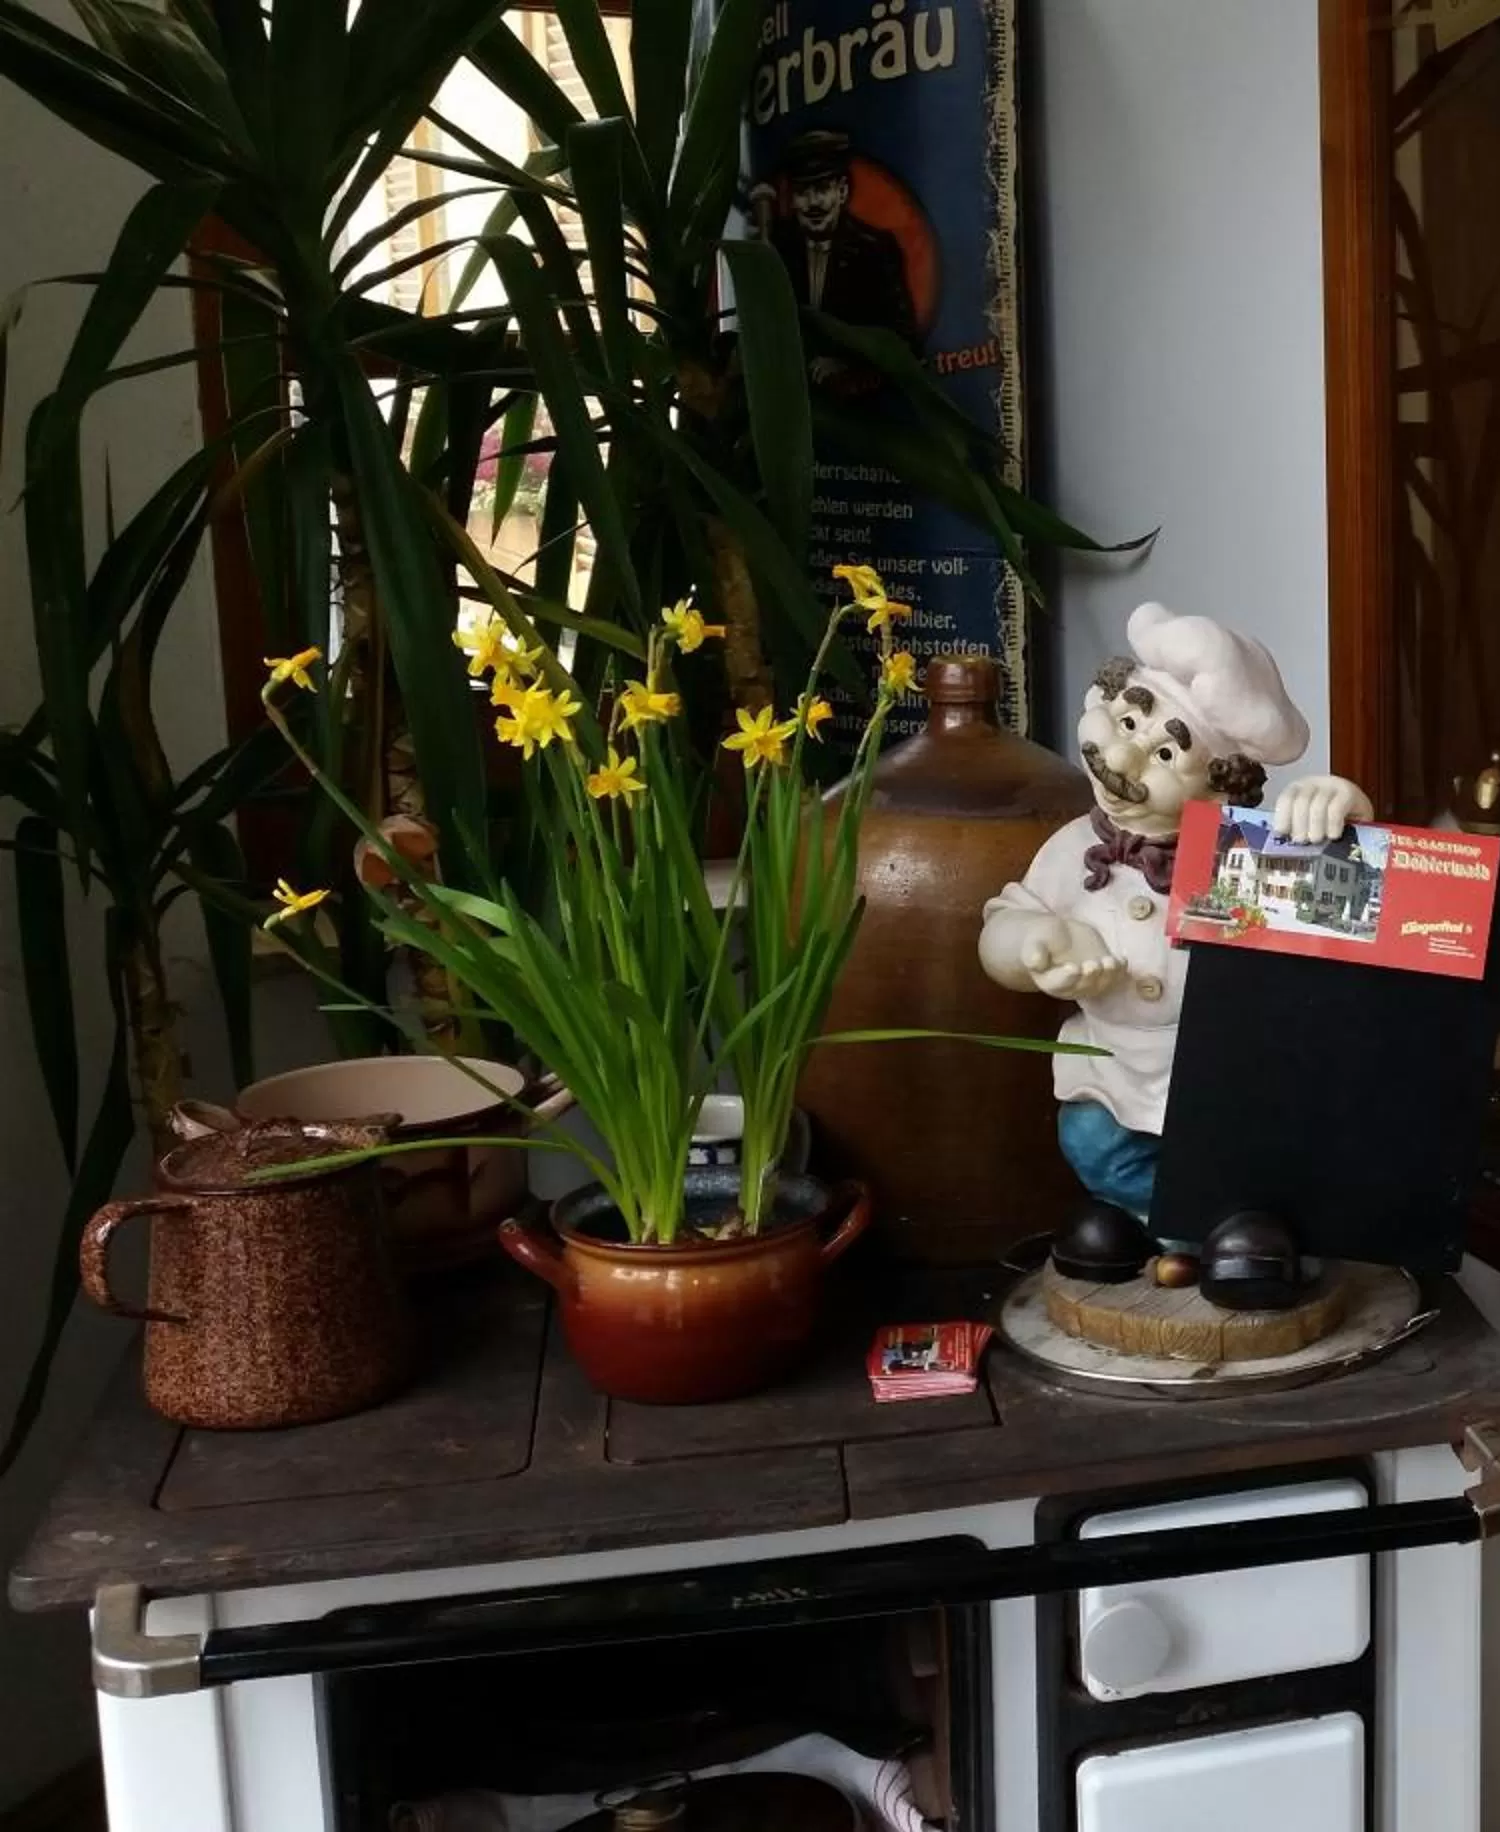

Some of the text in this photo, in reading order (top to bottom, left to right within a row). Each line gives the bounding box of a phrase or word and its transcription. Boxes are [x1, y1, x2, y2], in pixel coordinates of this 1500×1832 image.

[756, 0, 789, 48] ell
[750, 2, 956, 126] erbräu
[936, 340, 998, 373] treu!
[852, 499, 914, 521] werden
[876, 556, 928, 576] unser
[930, 556, 970, 577] voll-
